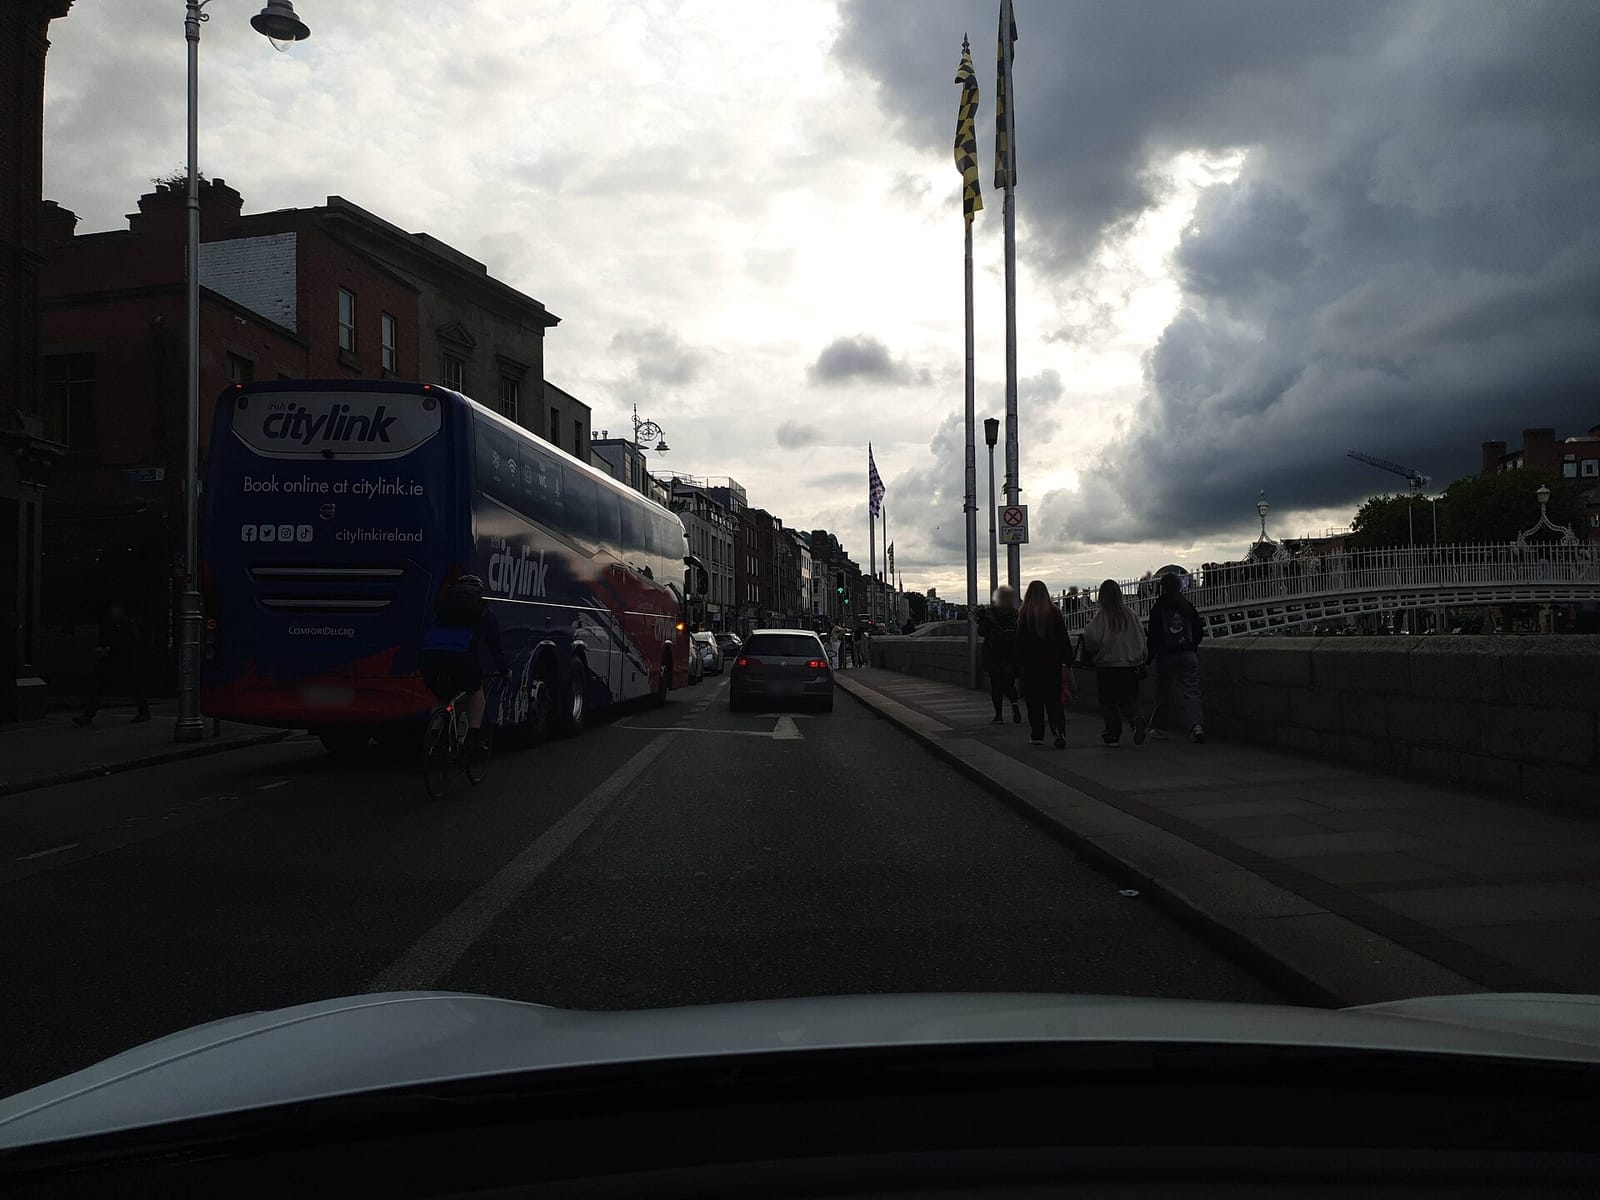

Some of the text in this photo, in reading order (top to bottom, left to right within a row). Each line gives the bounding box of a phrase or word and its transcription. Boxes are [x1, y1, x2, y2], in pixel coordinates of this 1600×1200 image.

[263, 403, 398, 445] citylink
[243, 475, 424, 500] Book online at citylink.ie
[335, 528, 424, 544] citylinkireland
[488, 539, 549, 599] citylink
